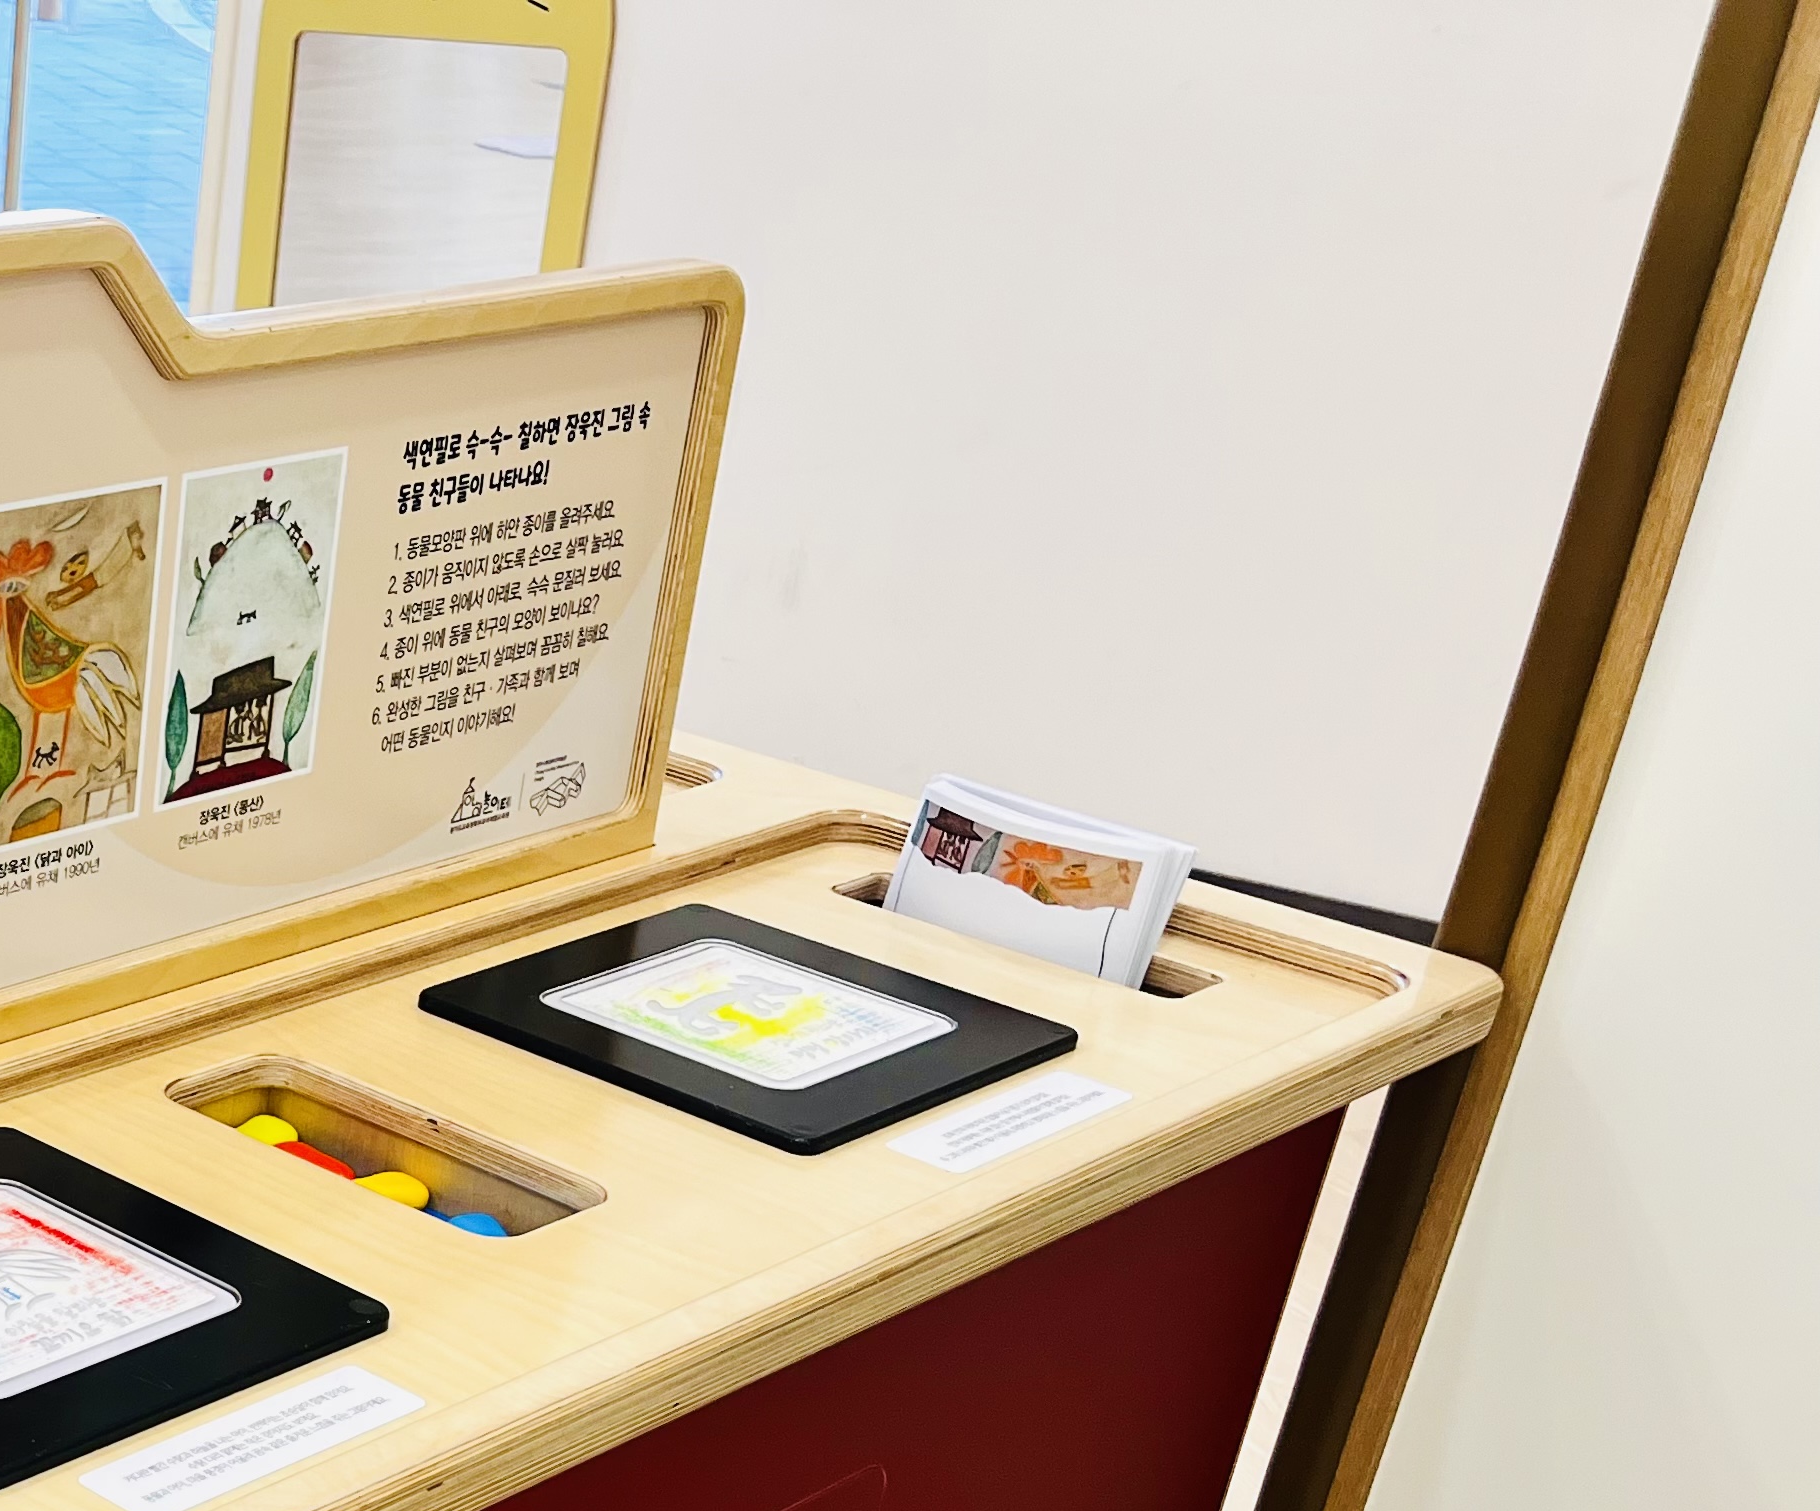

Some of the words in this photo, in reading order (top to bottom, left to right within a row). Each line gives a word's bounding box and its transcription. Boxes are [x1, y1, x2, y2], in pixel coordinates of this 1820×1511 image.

[403, 434, 462, 470] 색연필로
[518, 416, 561, 450] 칠하면
[565, 409, 605, 442] 장욱진
[607, 404, 635, 432] 그림
[638, 401, 650, 429] 속
[397, 482, 424, 514] 동물
[429, 473, 484, 507] 친구들이
[489, 459, 550, 492] 나타나요!
[395, 543, 402, 561] 1.
[407, 527, 466, 560] 동물모양판
[469, 522, 493, 546] 위에
[497, 517, 520, 541] 하얀
[522, 510, 556, 537] 종이를
[384, 609, 393, 628] 3.
[399, 598, 445, 625] 색연필로
[449, 588, 484, 614] 위에서
[527, 575, 549, 597] 슥슥
[552, 566, 586, 592] 문질러
[403, 565, 438, 593] 종이가
[442, 555, 489, 585] 움직이지
[492, 548, 525, 574] 않도록
[529, 542, 562, 566] 손으로
[380, 642, 389, 660] 4.
[394, 634, 419, 659] 종이
[422, 627, 446, 652] 위에
[449, 622, 472, 647] 동물
[476, 613, 510, 640] 친구의
[512, 605, 546, 630] 모양이
[548, 594, 600, 622] 보이나요?
[372, 707, 381, 725] 6.
[386, 696, 422, 723] 완성한
[424, 687, 459, 711] 그림을
[463, 681, 485, 704] 친구
[496, 670, 530, 695] 가족과
[557, 658, 580, 680] 보며
[376, 675, 385, 693] 5.
[390, 666, 415, 690] 빠진
[417, 657, 453, 684] 부분이
[457, 648, 490, 676] 없는지
[494, 638, 538, 667] 살펴보며
[541, 630, 574, 656] 꼼꼼히
[381, 731, 405, 753] 어떤
[408, 718, 454, 748] 동물인지
[457, 703, 516, 734] 이야기해요!
